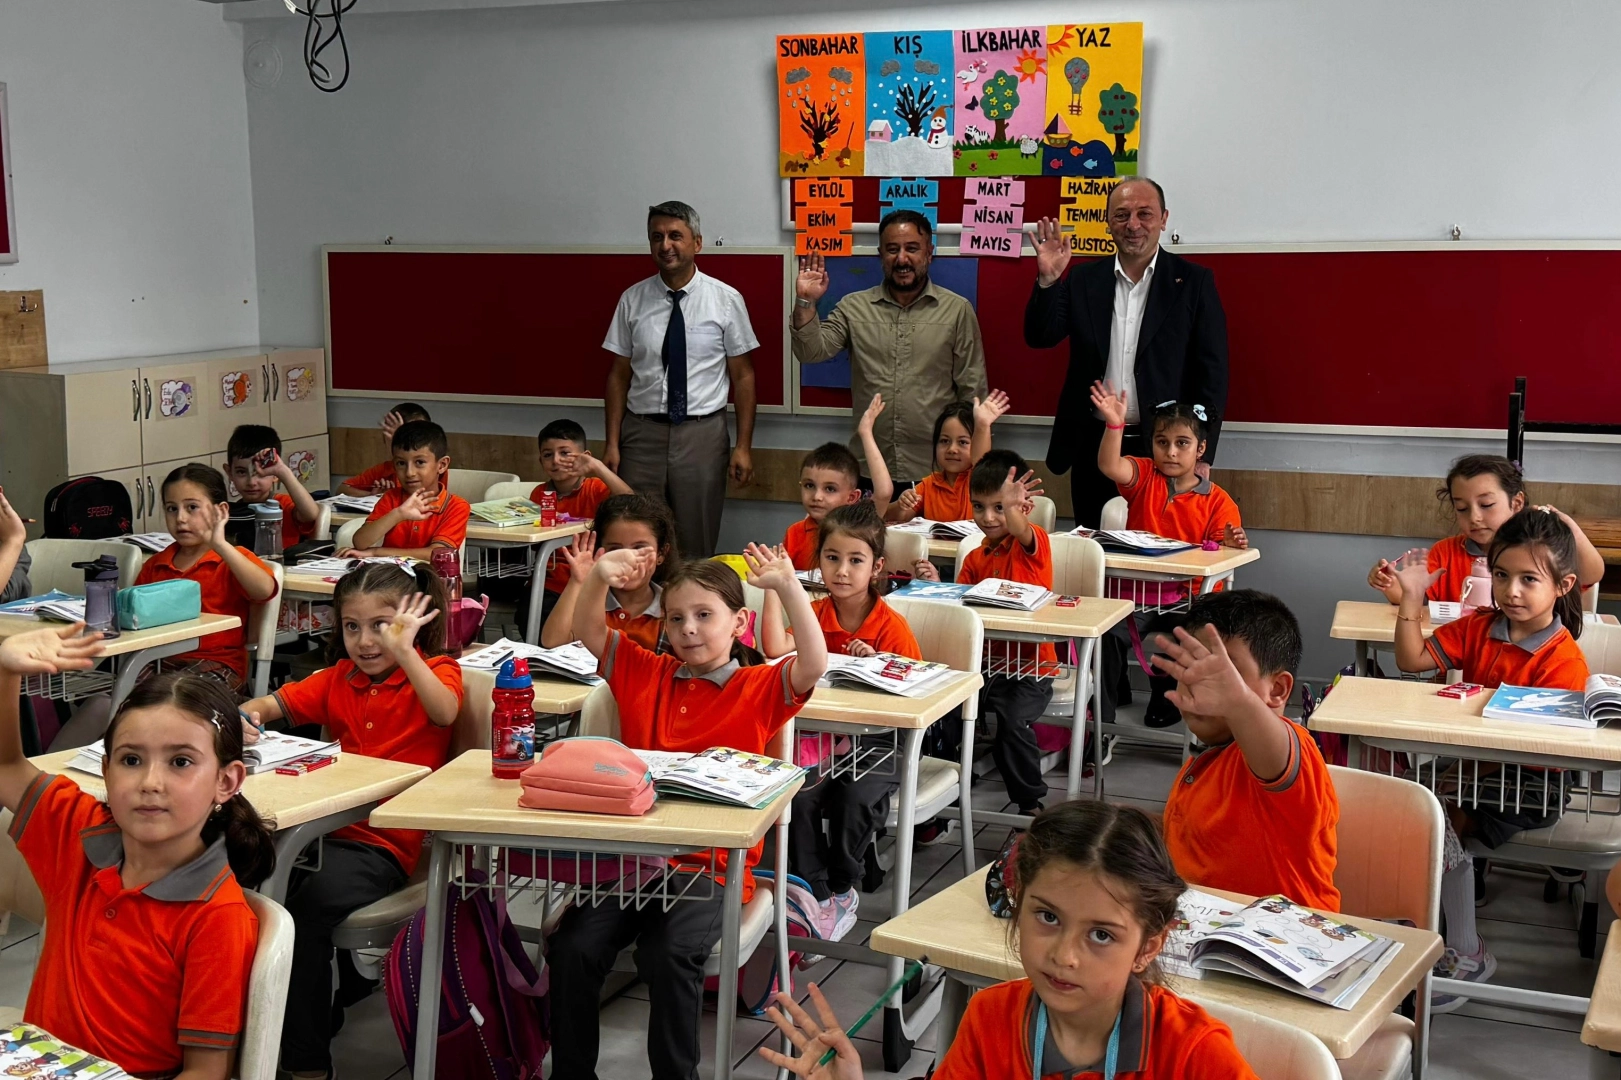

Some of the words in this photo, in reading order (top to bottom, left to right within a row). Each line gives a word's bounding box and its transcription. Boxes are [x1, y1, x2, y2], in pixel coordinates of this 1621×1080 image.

[961, 28, 1043, 53] İLKBAHAR
[1075, 27, 1111, 48] YAZ
[779, 35, 859, 58] SONBAHAR
[893, 35, 923, 58] KIŞ
[885, 183, 928, 199] ARALIK
[977, 181, 1011, 197] MART
[807, 210, 836, 227] EKİM
[973, 206, 1014, 224] NİSAN
[1066, 207, 1108, 223] TEMMU
[806, 237, 843, 251] KASIM
[970, 235, 1012, 252] MAYIS
[1069, 234, 1115, 253] ĞUSTOS
